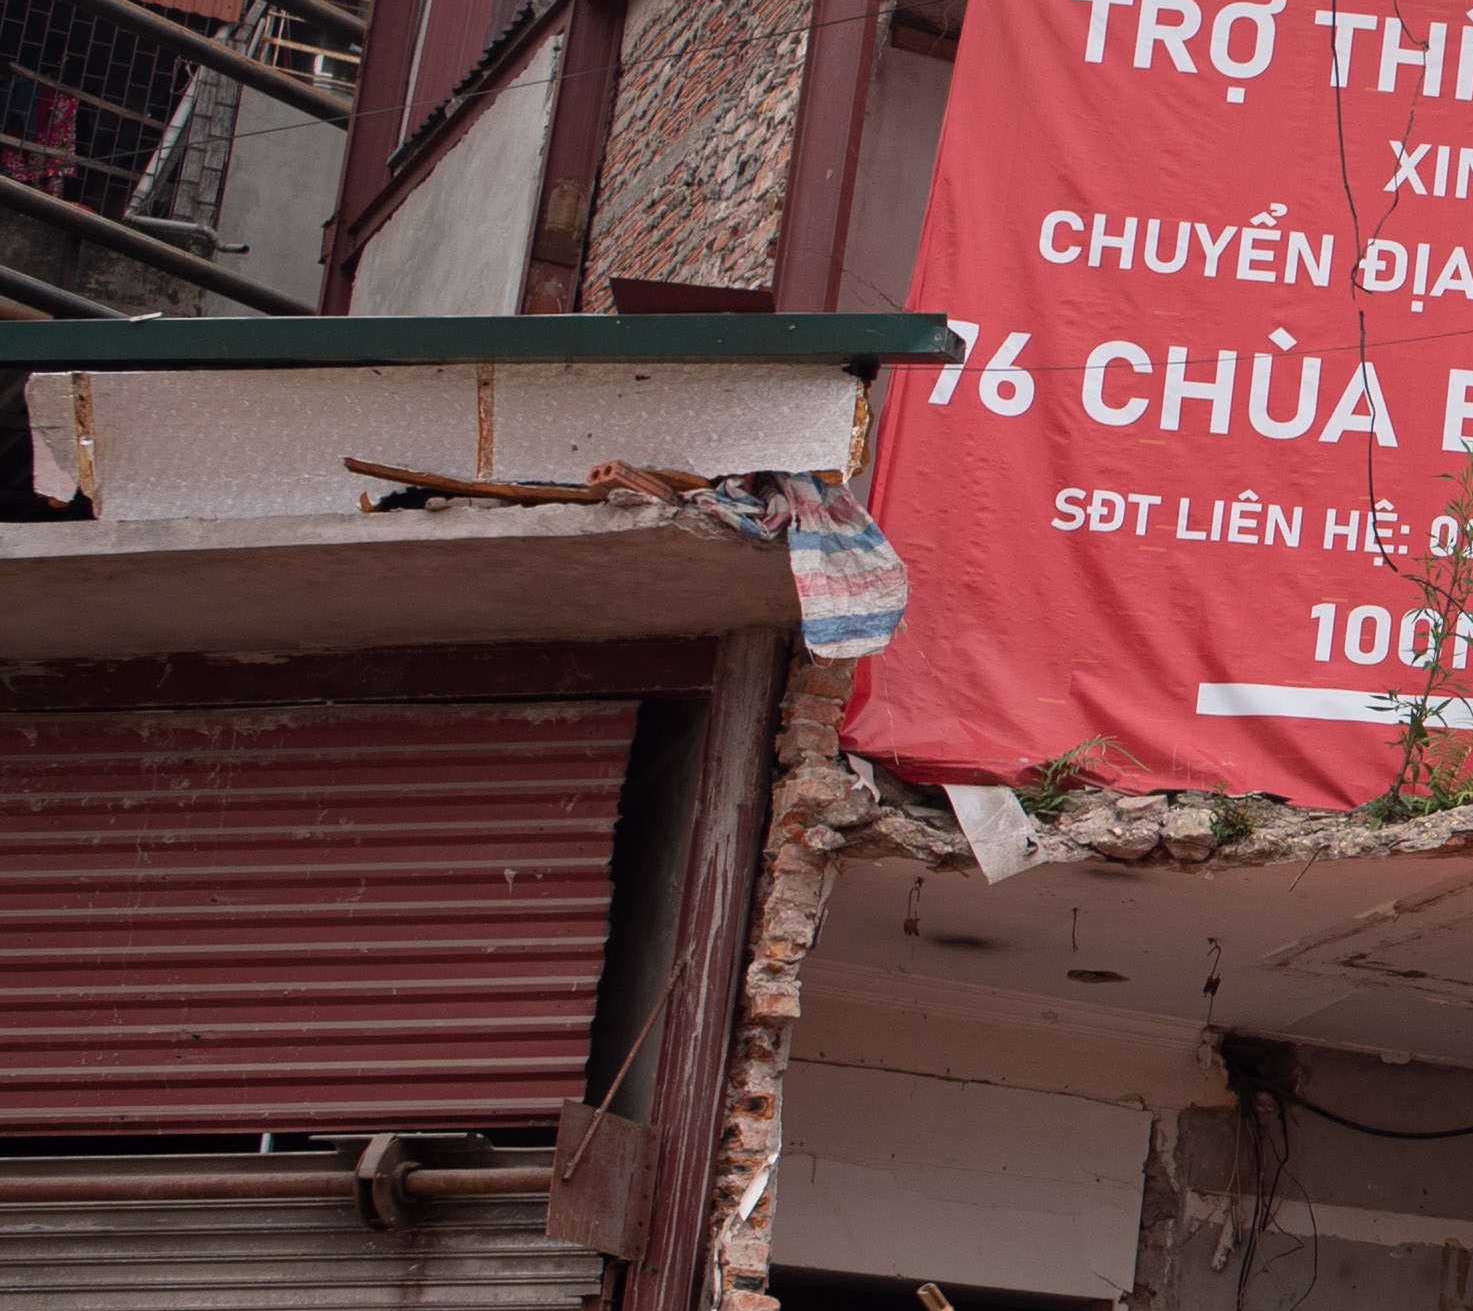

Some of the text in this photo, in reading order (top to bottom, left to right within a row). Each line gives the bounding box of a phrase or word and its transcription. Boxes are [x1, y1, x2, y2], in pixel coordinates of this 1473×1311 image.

[1039, 203, 1334, 287] CHUYỂN
[1082, 326, 1398, 448] CHÙA
[1050, 487, 1161, 537] SĐT
[1177, 489, 1302, 547] LIÊN
[1323, 499, 1408, 567] HỆ:
